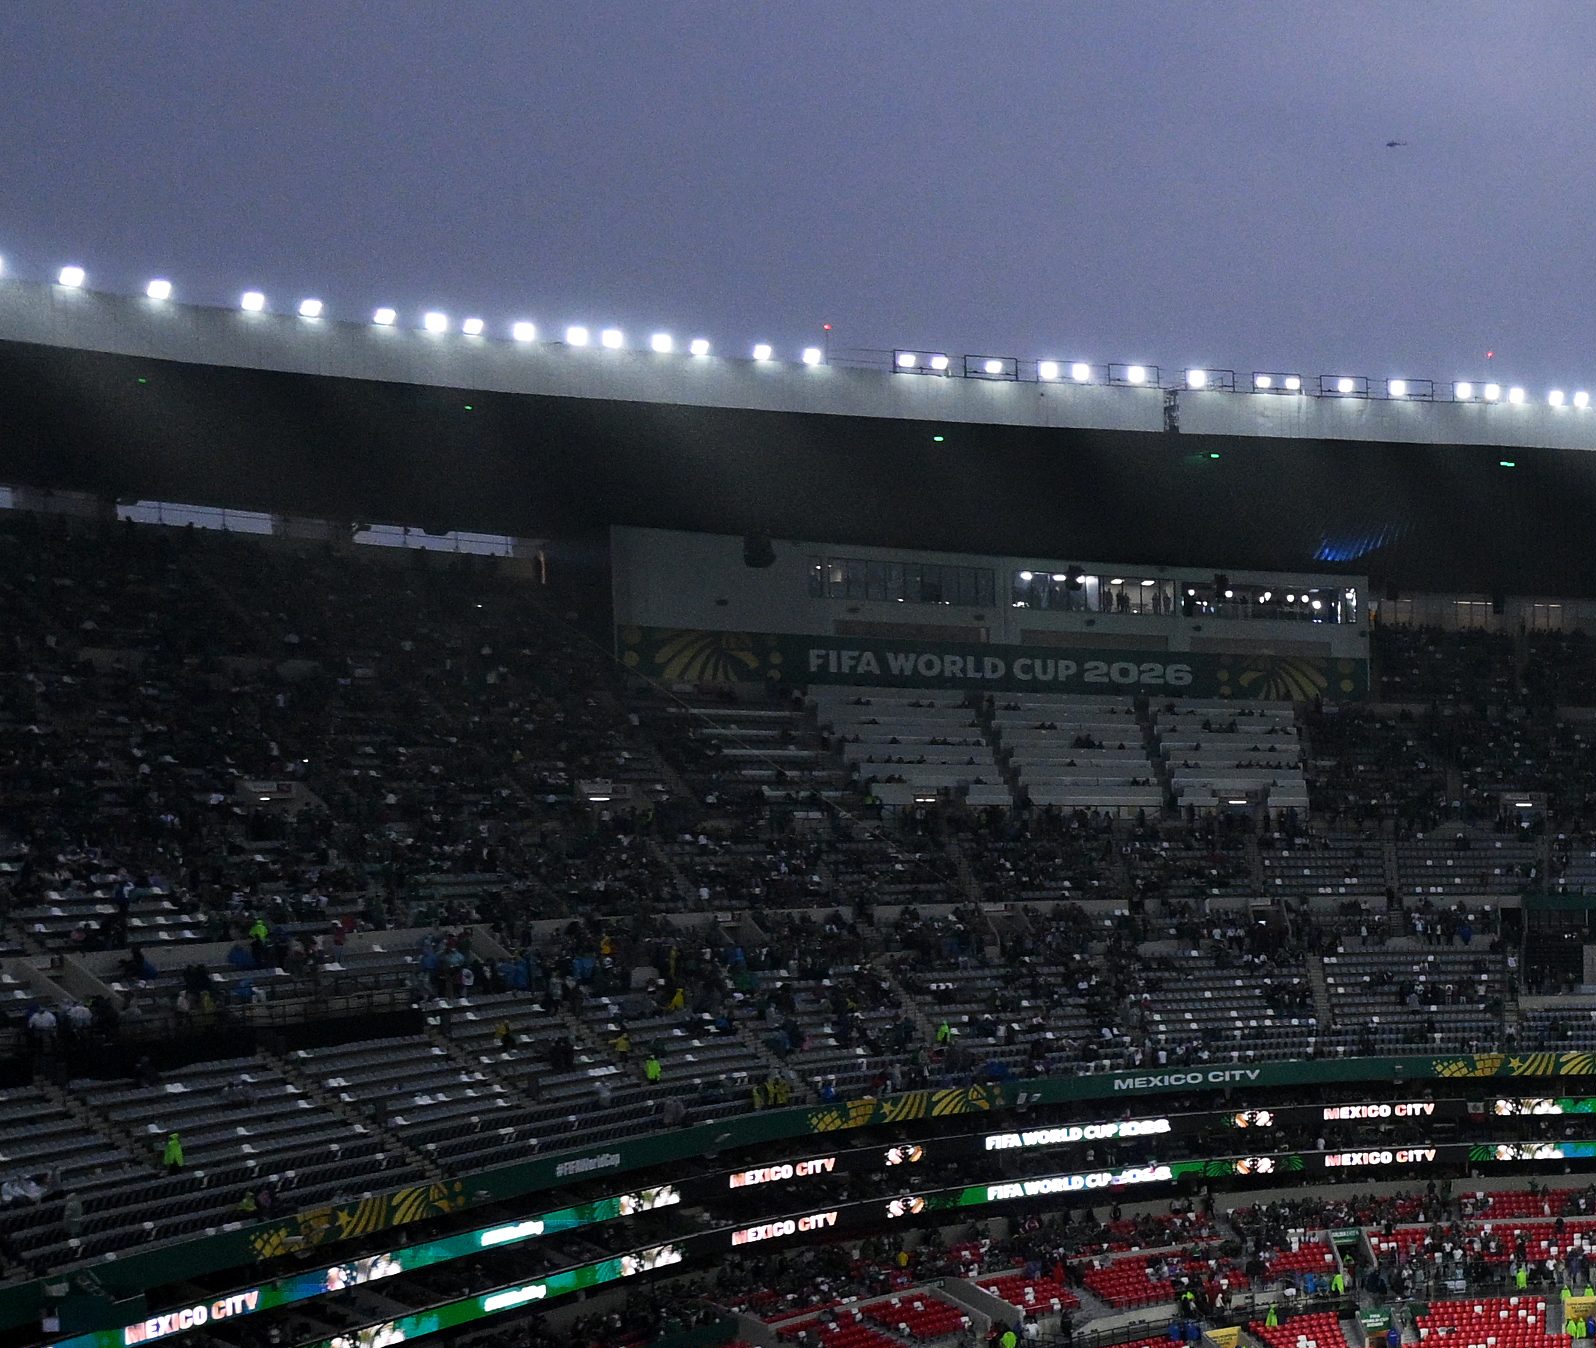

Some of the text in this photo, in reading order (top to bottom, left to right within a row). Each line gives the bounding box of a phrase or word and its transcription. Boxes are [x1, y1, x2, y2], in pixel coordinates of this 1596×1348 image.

[808, 649, 1192, 685] FIFA WORLD CUP 2026
[1114, 1069, 1260, 1090] MEXICO CITY
[1323, 1103, 1434, 1120] MEXICO CITY
[986, 1133, 1022, 1151] FIFA
[1021, 1126, 1082, 1146] WORLD
[1083, 1122, 1119, 1141] CUP
[729, 1157, 835, 1188] MEXICO CITY
[1325, 1149, 1436, 1167] MEXICO CITY
[987, 1183, 1024, 1201] FIFA
[1023, 1175, 1083, 1196] WORLD
[731, 1212, 837, 1246] MEXICO CITY
[125, 1290, 259, 1345] MEXICO CITY
